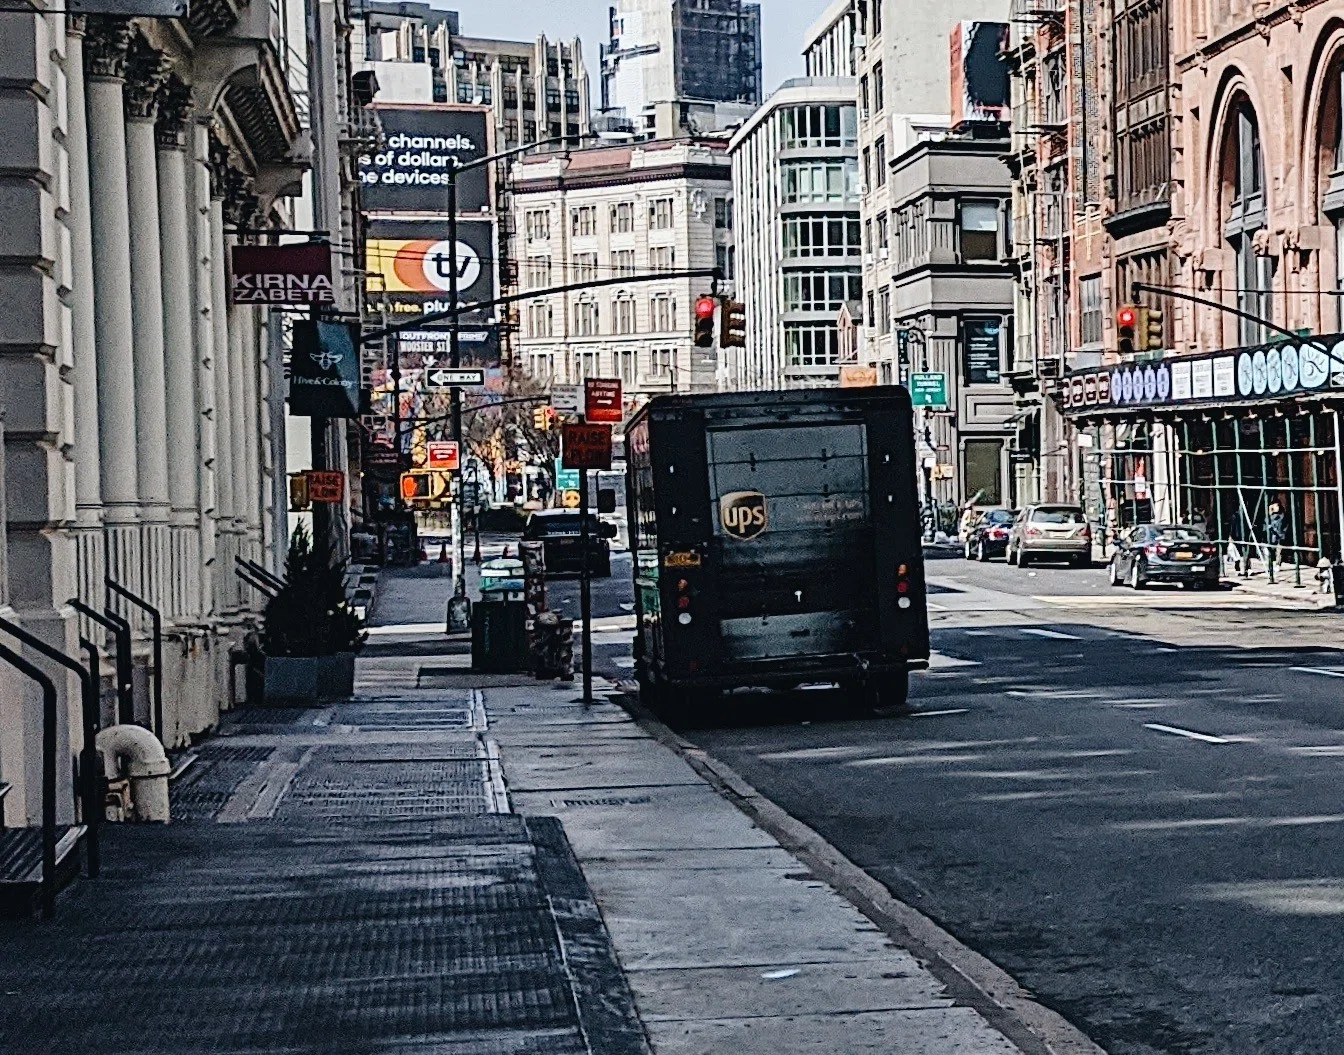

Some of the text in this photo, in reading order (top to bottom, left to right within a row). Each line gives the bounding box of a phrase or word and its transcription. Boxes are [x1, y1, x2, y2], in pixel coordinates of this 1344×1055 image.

[388, 133, 476, 150] channels.
[374, 151, 394, 166] of
[431, 252, 472, 280] tv
[231, 273, 332, 289] KIRNA
[395, 301, 422, 313] free.
[400, 331, 450, 341] OUTFRON
[724, 505, 764, 534] ups
